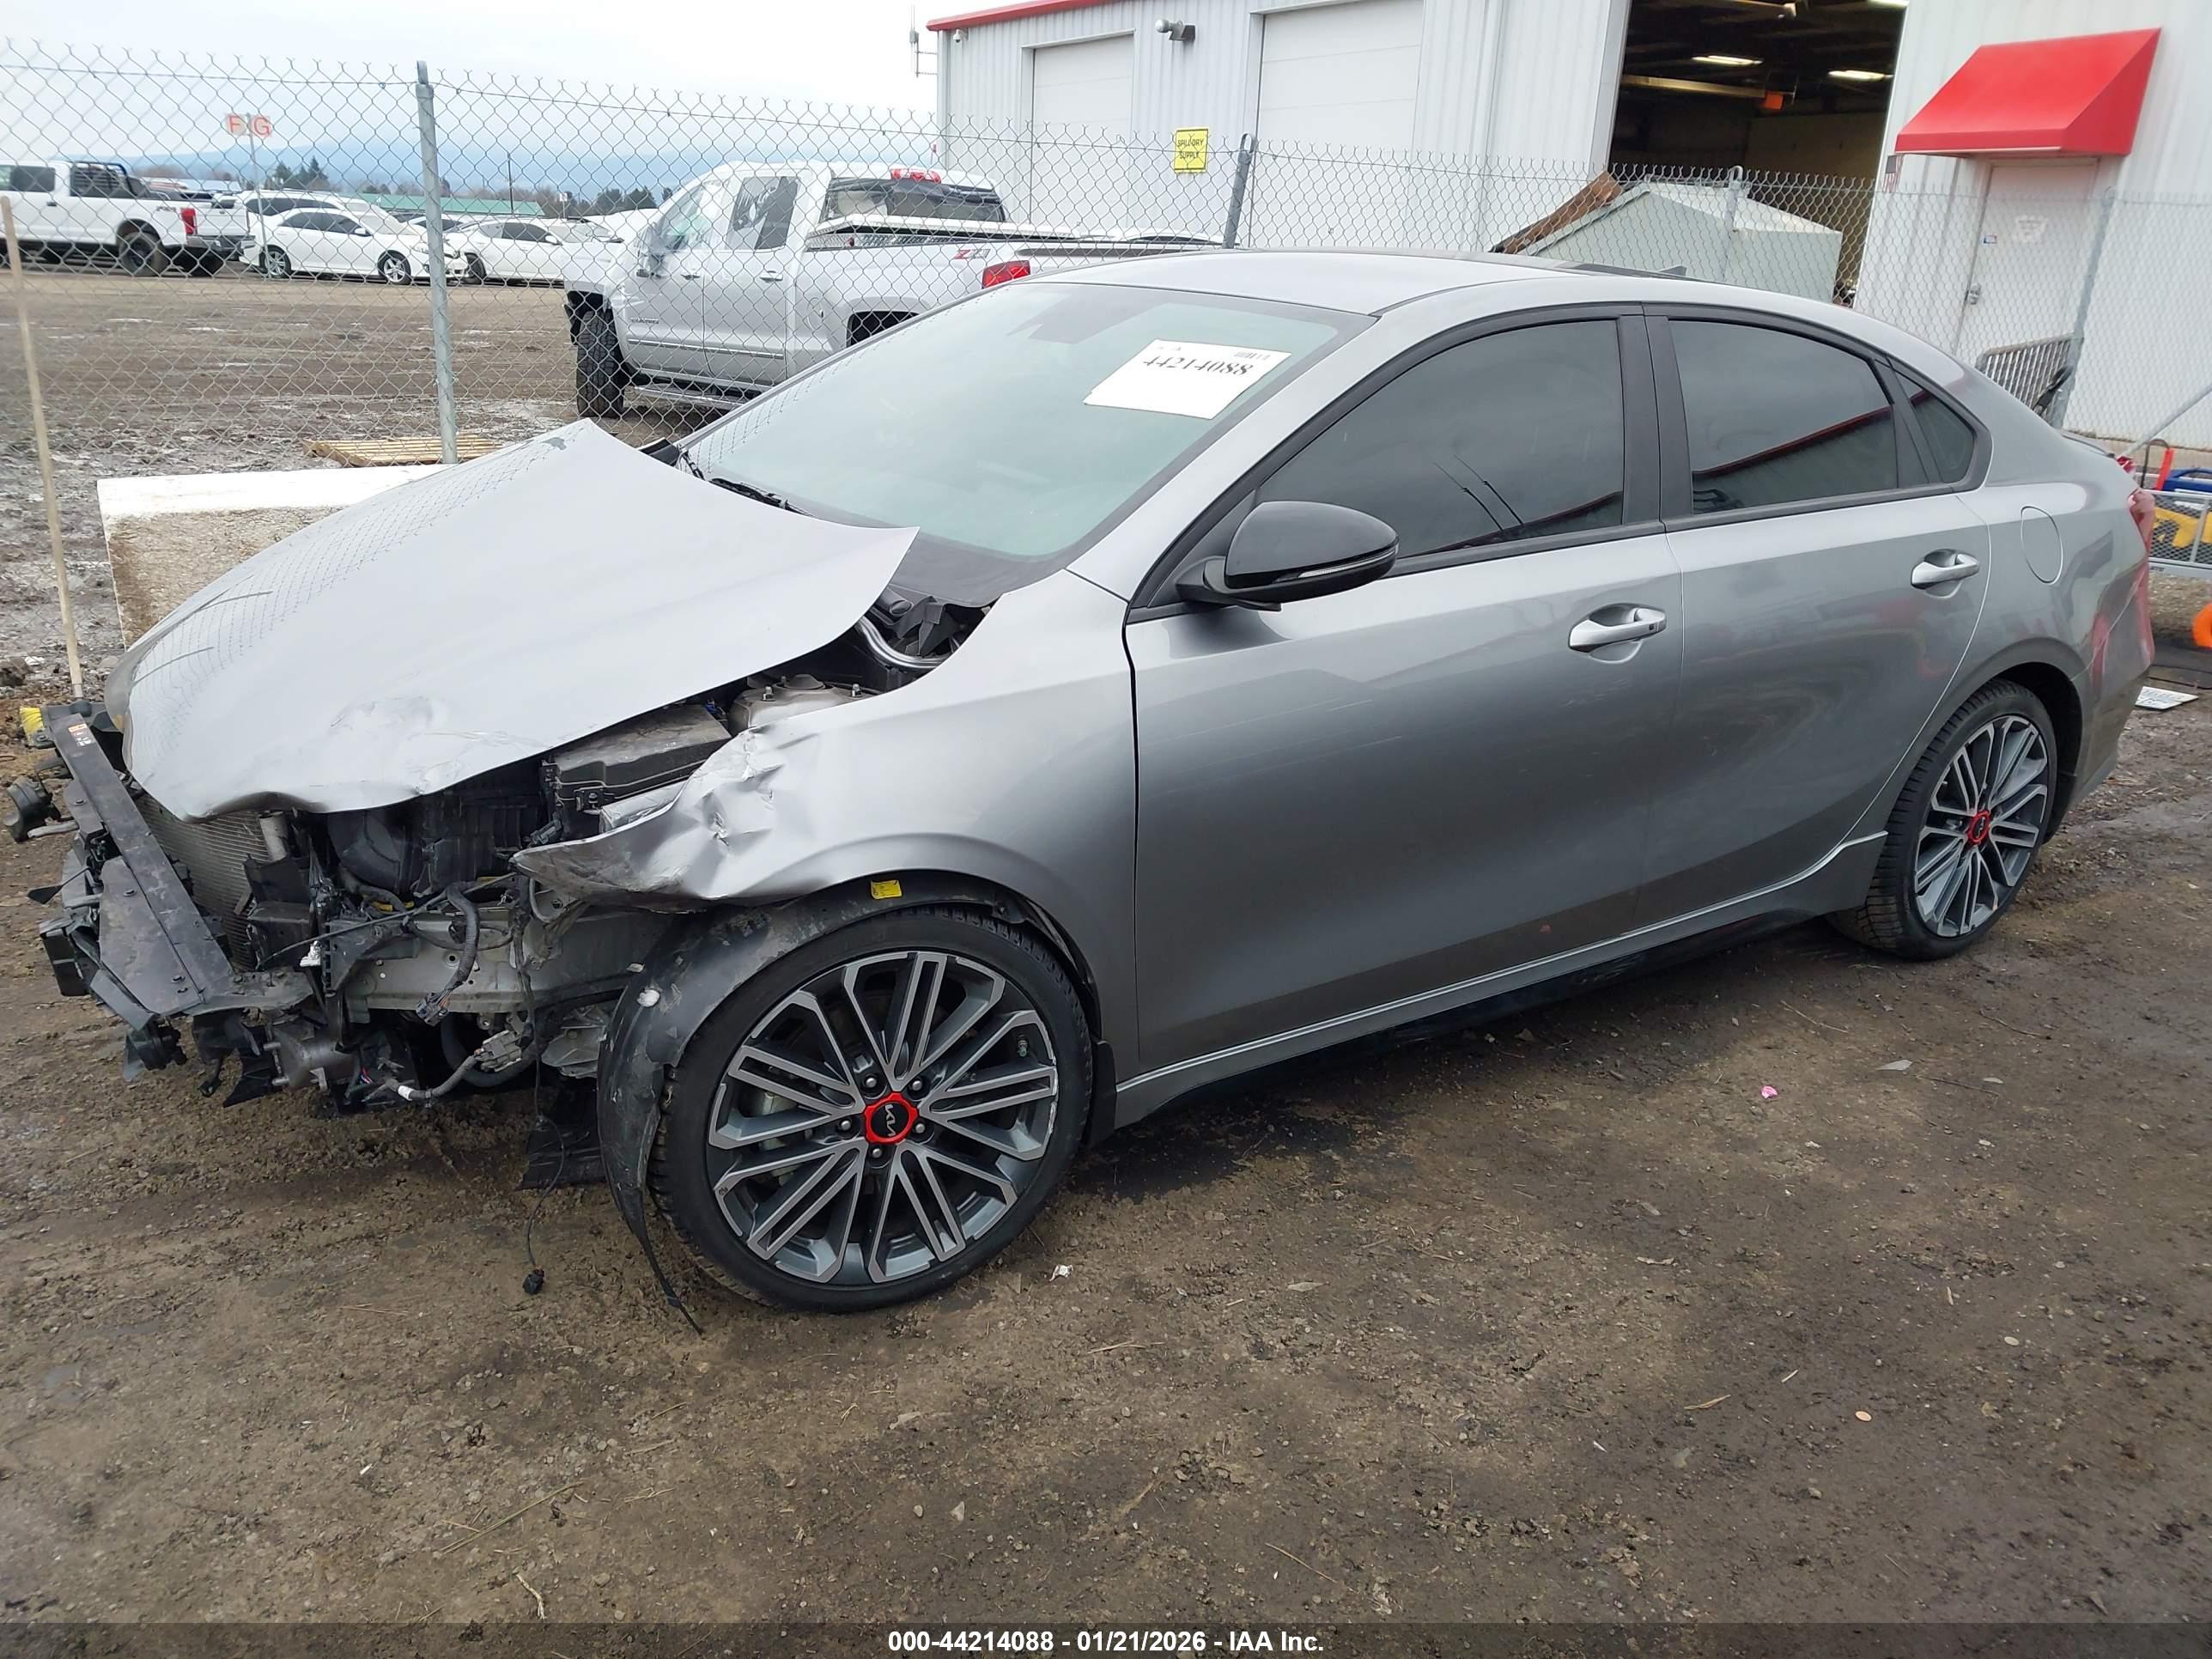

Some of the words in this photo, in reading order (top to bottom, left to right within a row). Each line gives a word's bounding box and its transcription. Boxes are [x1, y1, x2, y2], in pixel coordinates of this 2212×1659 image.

[1192, 137, 1205, 146] DRY
[1179, 150, 1200, 159] SUPPLY
[1143, 356, 1254, 375] 44214088
